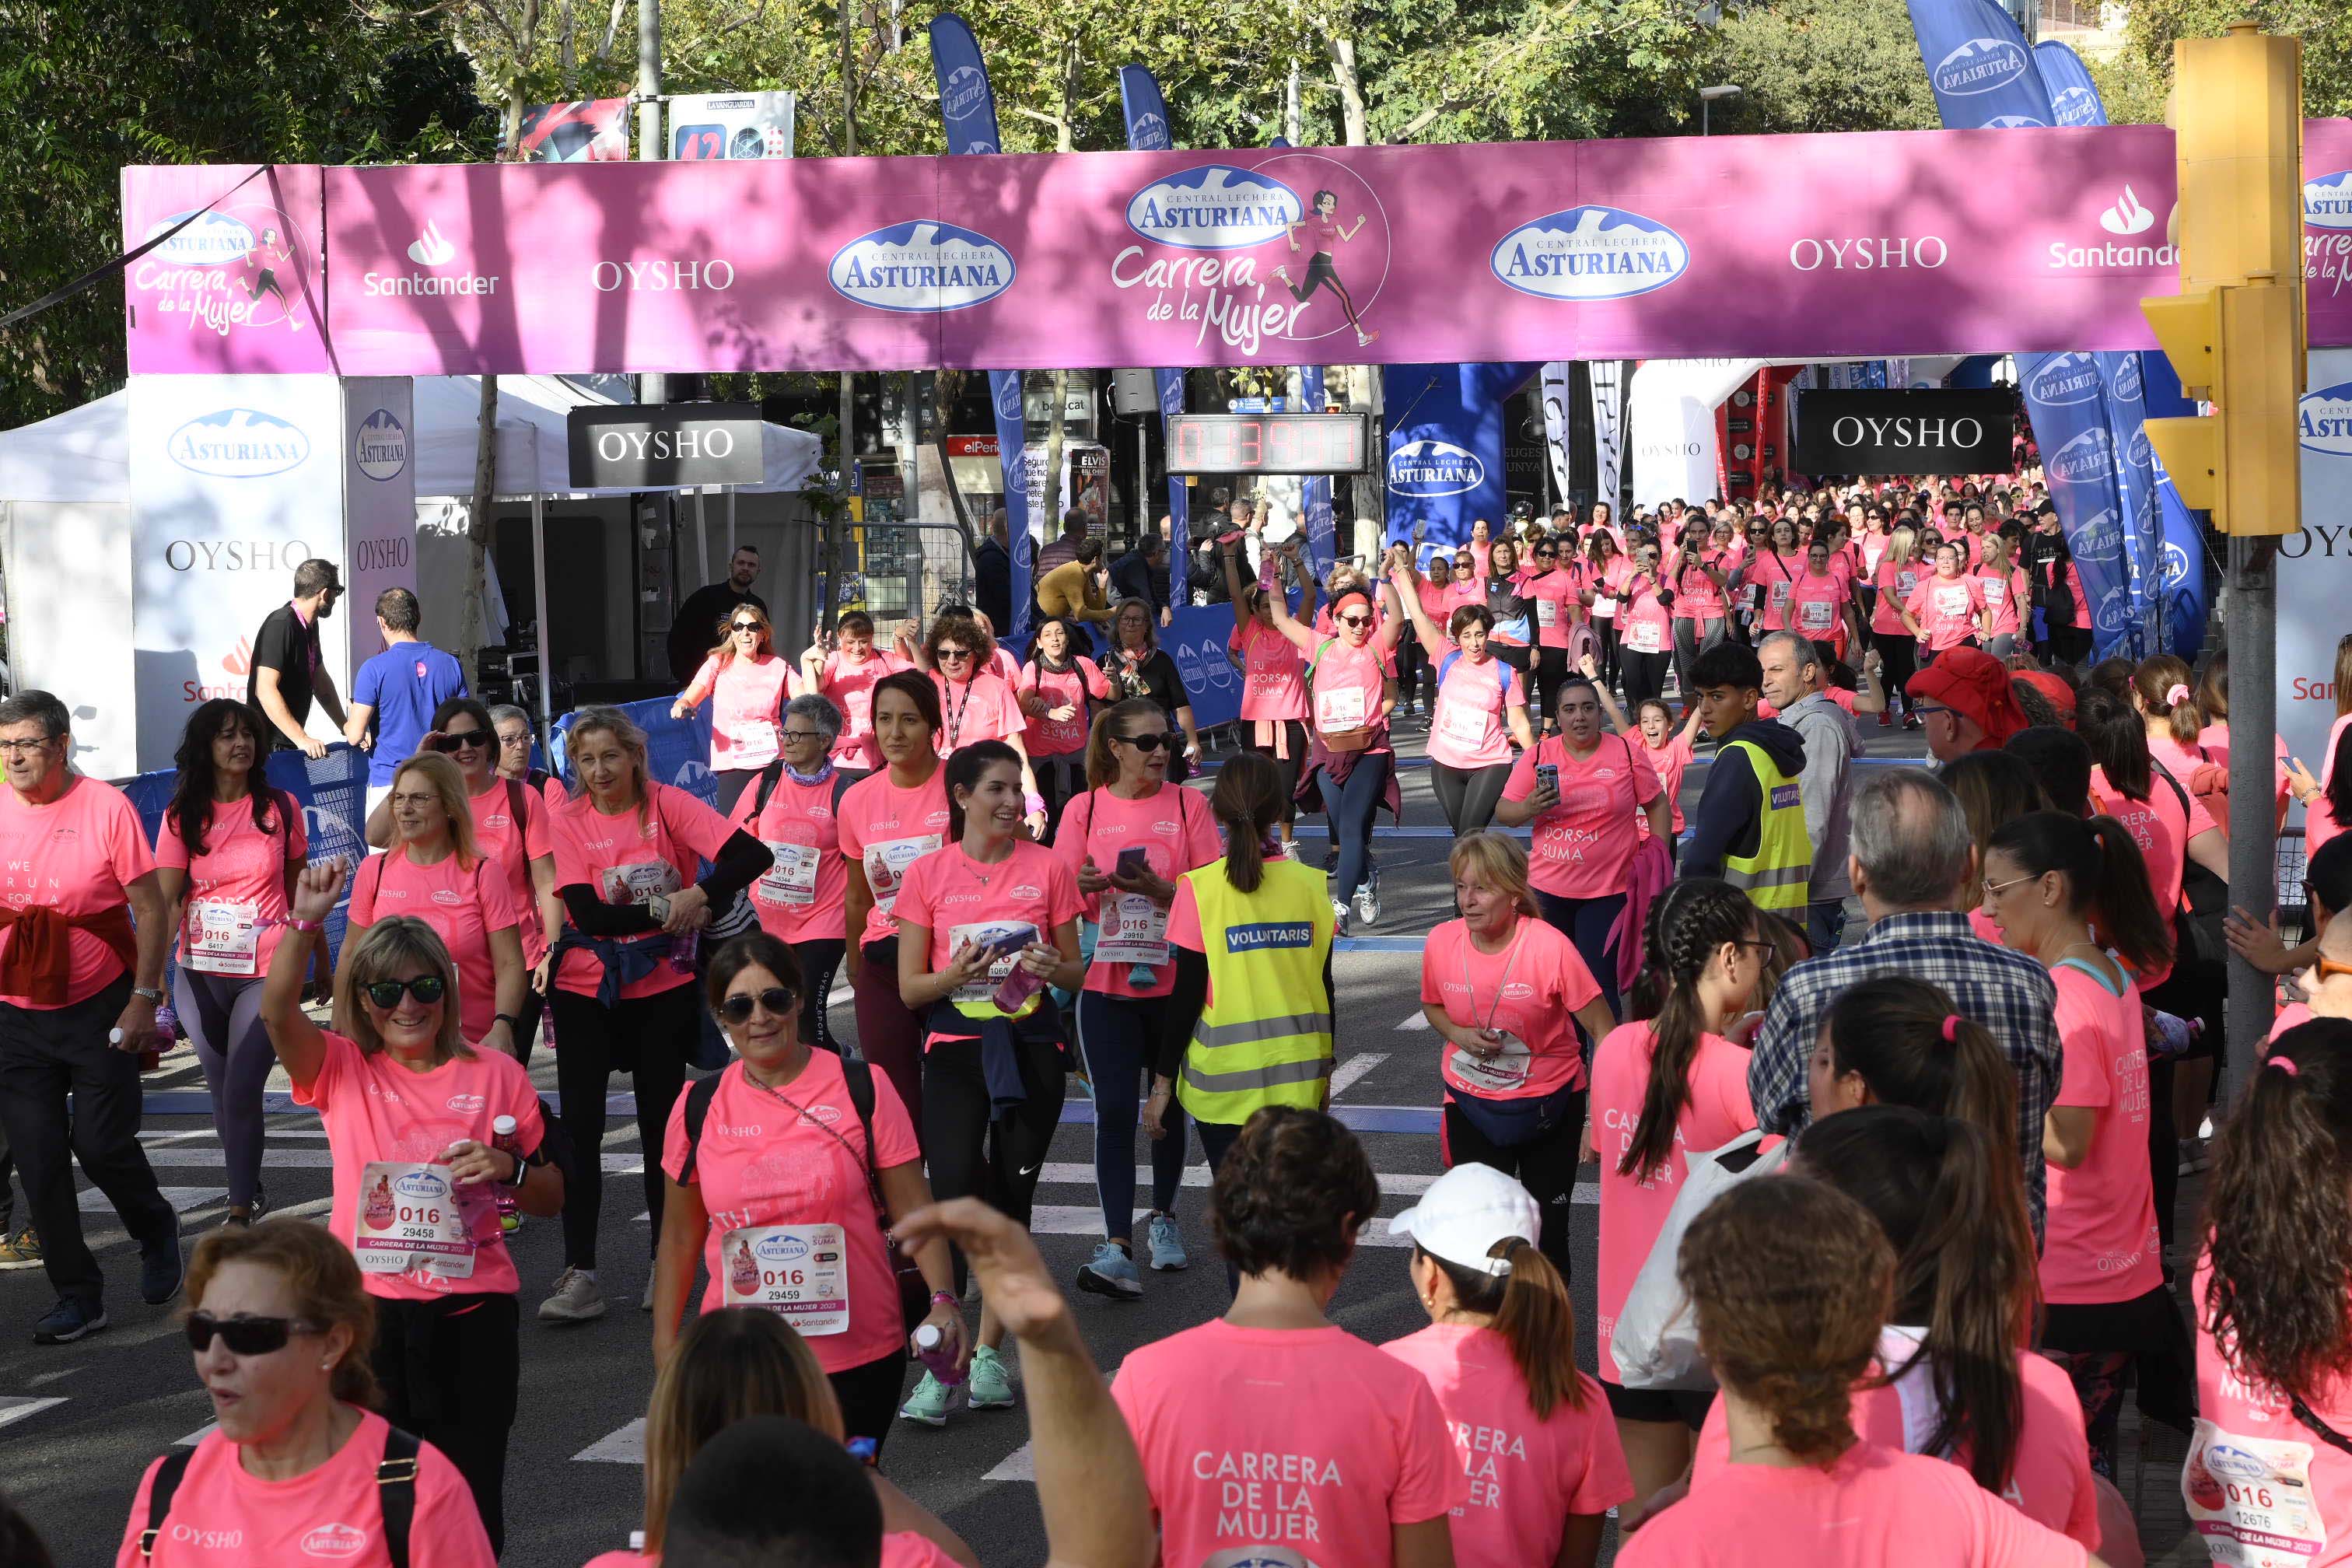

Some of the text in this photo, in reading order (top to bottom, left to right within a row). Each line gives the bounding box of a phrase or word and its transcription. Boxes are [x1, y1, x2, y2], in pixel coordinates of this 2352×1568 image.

[716, 100, 754, 109] VANGUARDIA
[1167, 192, 1284, 203] CENTRAL LECHERA
[1139, 197, 1288, 229] ASTURIANA
[1537, 237, 1667, 249] CENTRAL LECHERA
[872, 251, 995, 261] CENTRAL LECHERA
[1506, 242, 1673, 277] ASTURIANA
[1790, 236, 1947, 270] OYSHO
[2049, 242, 2180, 268] Santand
[135, 261, 226, 290] Carrera
[591, 260, 735, 292] OYSHO
[843, 255, 1001, 289] ASTURIANA
[1111, 246, 1256, 289] Carrera
[2321, 257, 2335, 278] la
[364, 271, 499, 296] Santander
[158, 290, 261, 335] de la Mujer
[1147, 283, 1311, 355] de la Mujer
[1832, 417, 1983, 448] OYSHO
[180, 436, 299, 460] ASTURIANA
[359, 440, 404, 463] ASTURIANA
[598, 428, 733, 462] OYSHO
[1082, 457, 1105, 465] ELVIS
[1389, 464, 1477, 485] ASTURIANA
[166, 541, 312, 571] OYSHO
[357, 537, 408, 572] OYSHO
[1254, 661, 1264, 670] TU
[1253, 687, 1283, 696] SUMA
[870, 821, 900, 831] OYSHO
[1097, 825, 1125, 836] OYSHO
[889, 851, 916, 859] ASTURIANA
[1542, 844, 1584, 860] SUMA
[8, 861, 31, 872] WE
[775, 865, 795, 876] 016
[630, 870, 660, 882] ASTURIANA
[9, 894, 59, 904] FOR A
[379, 890, 406, 898] OYSHO
[635, 884, 662, 897] 016
[945, 894, 981, 905] OYSHO
[1122, 920, 1148, 929] 016
[205, 930, 229, 941] 016
[1228, 929, 1309, 946] VOLUNTARIS
[1444, 982, 1473, 994] OYSHO
[2123, 1072, 2147, 1094] DE LA
[718, 1124, 761, 1137] OYSHO
[400, 1181, 443, 1194] ASTURIANA
[400, 1206, 440, 1223] 016
[403, 1227, 434, 1238] 29458
[369, 1240, 403, 1248] CARRERA
[758, 1244, 805, 1255] ASTURIANA
[366, 1255, 465, 1269] OYSHO Santander
[764, 1269, 804, 1286] 016
[768, 1290, 800, 1300] 29459
[801, 1318, 839, 1327] Santander
[1194, 1451, 1342, 1486] CARRERA
[1465, 1451, 1496, 1481] LA
[1223, 1482, 1314, 1513] DE LA
[2227, 1483, 2273, 1508] 016
[1216, 1510, 1320, 1542] MUJER
[2235, 1510, 2272, 1528] 12676
[172, 1524, 243, 1549] OYSHO
[310, 1535, 362, 1550] ASTURIANA
[2241, 1532, 2252, 1541] DE
[2252, 1534, 2264, 1543] LA
[2265, 1535, 2292, 1549] MUJER
